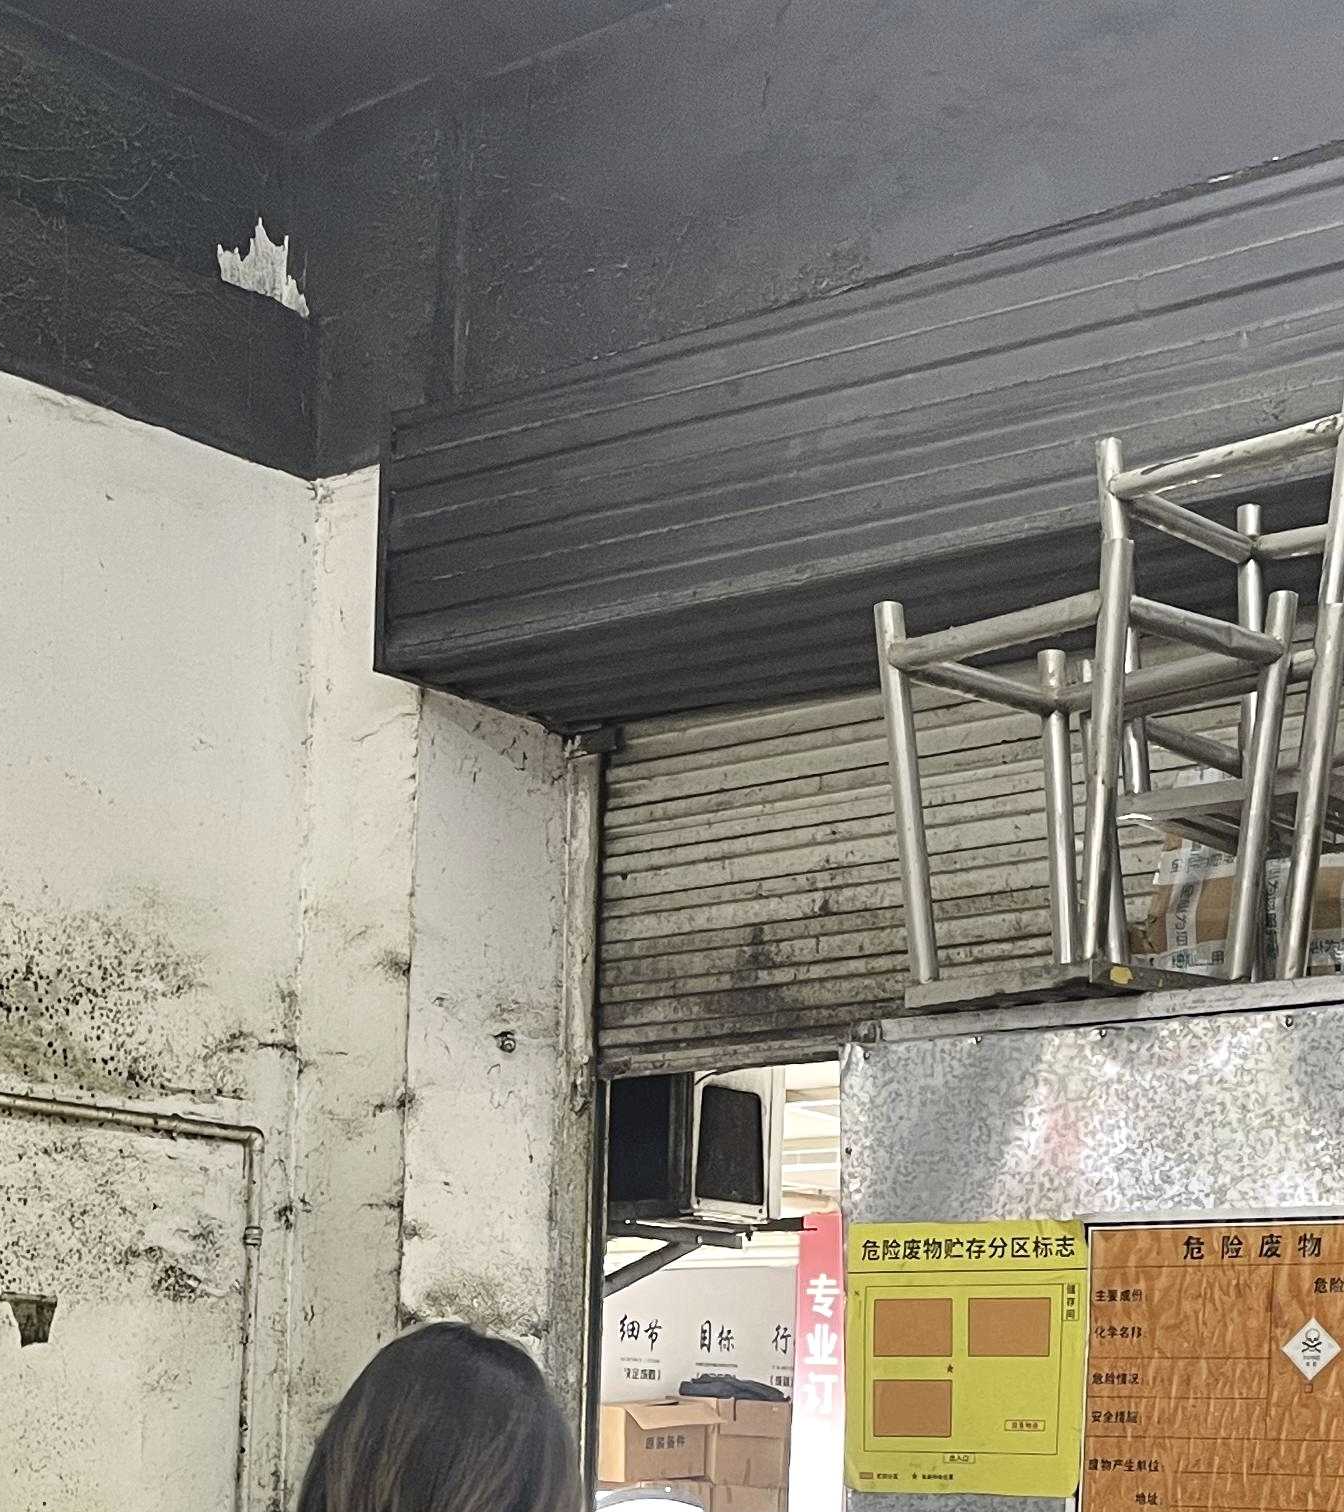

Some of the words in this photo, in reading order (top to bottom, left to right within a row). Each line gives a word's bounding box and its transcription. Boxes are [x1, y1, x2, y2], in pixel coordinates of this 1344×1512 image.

[861, 1235, 1075, 1261] 危险废物贮存分区标志
[1183, 1234, 1323, 1260] 危险废物
[619, 1314, 662, 1352] 细节
[700, 1320, 736, 1353] 目标
